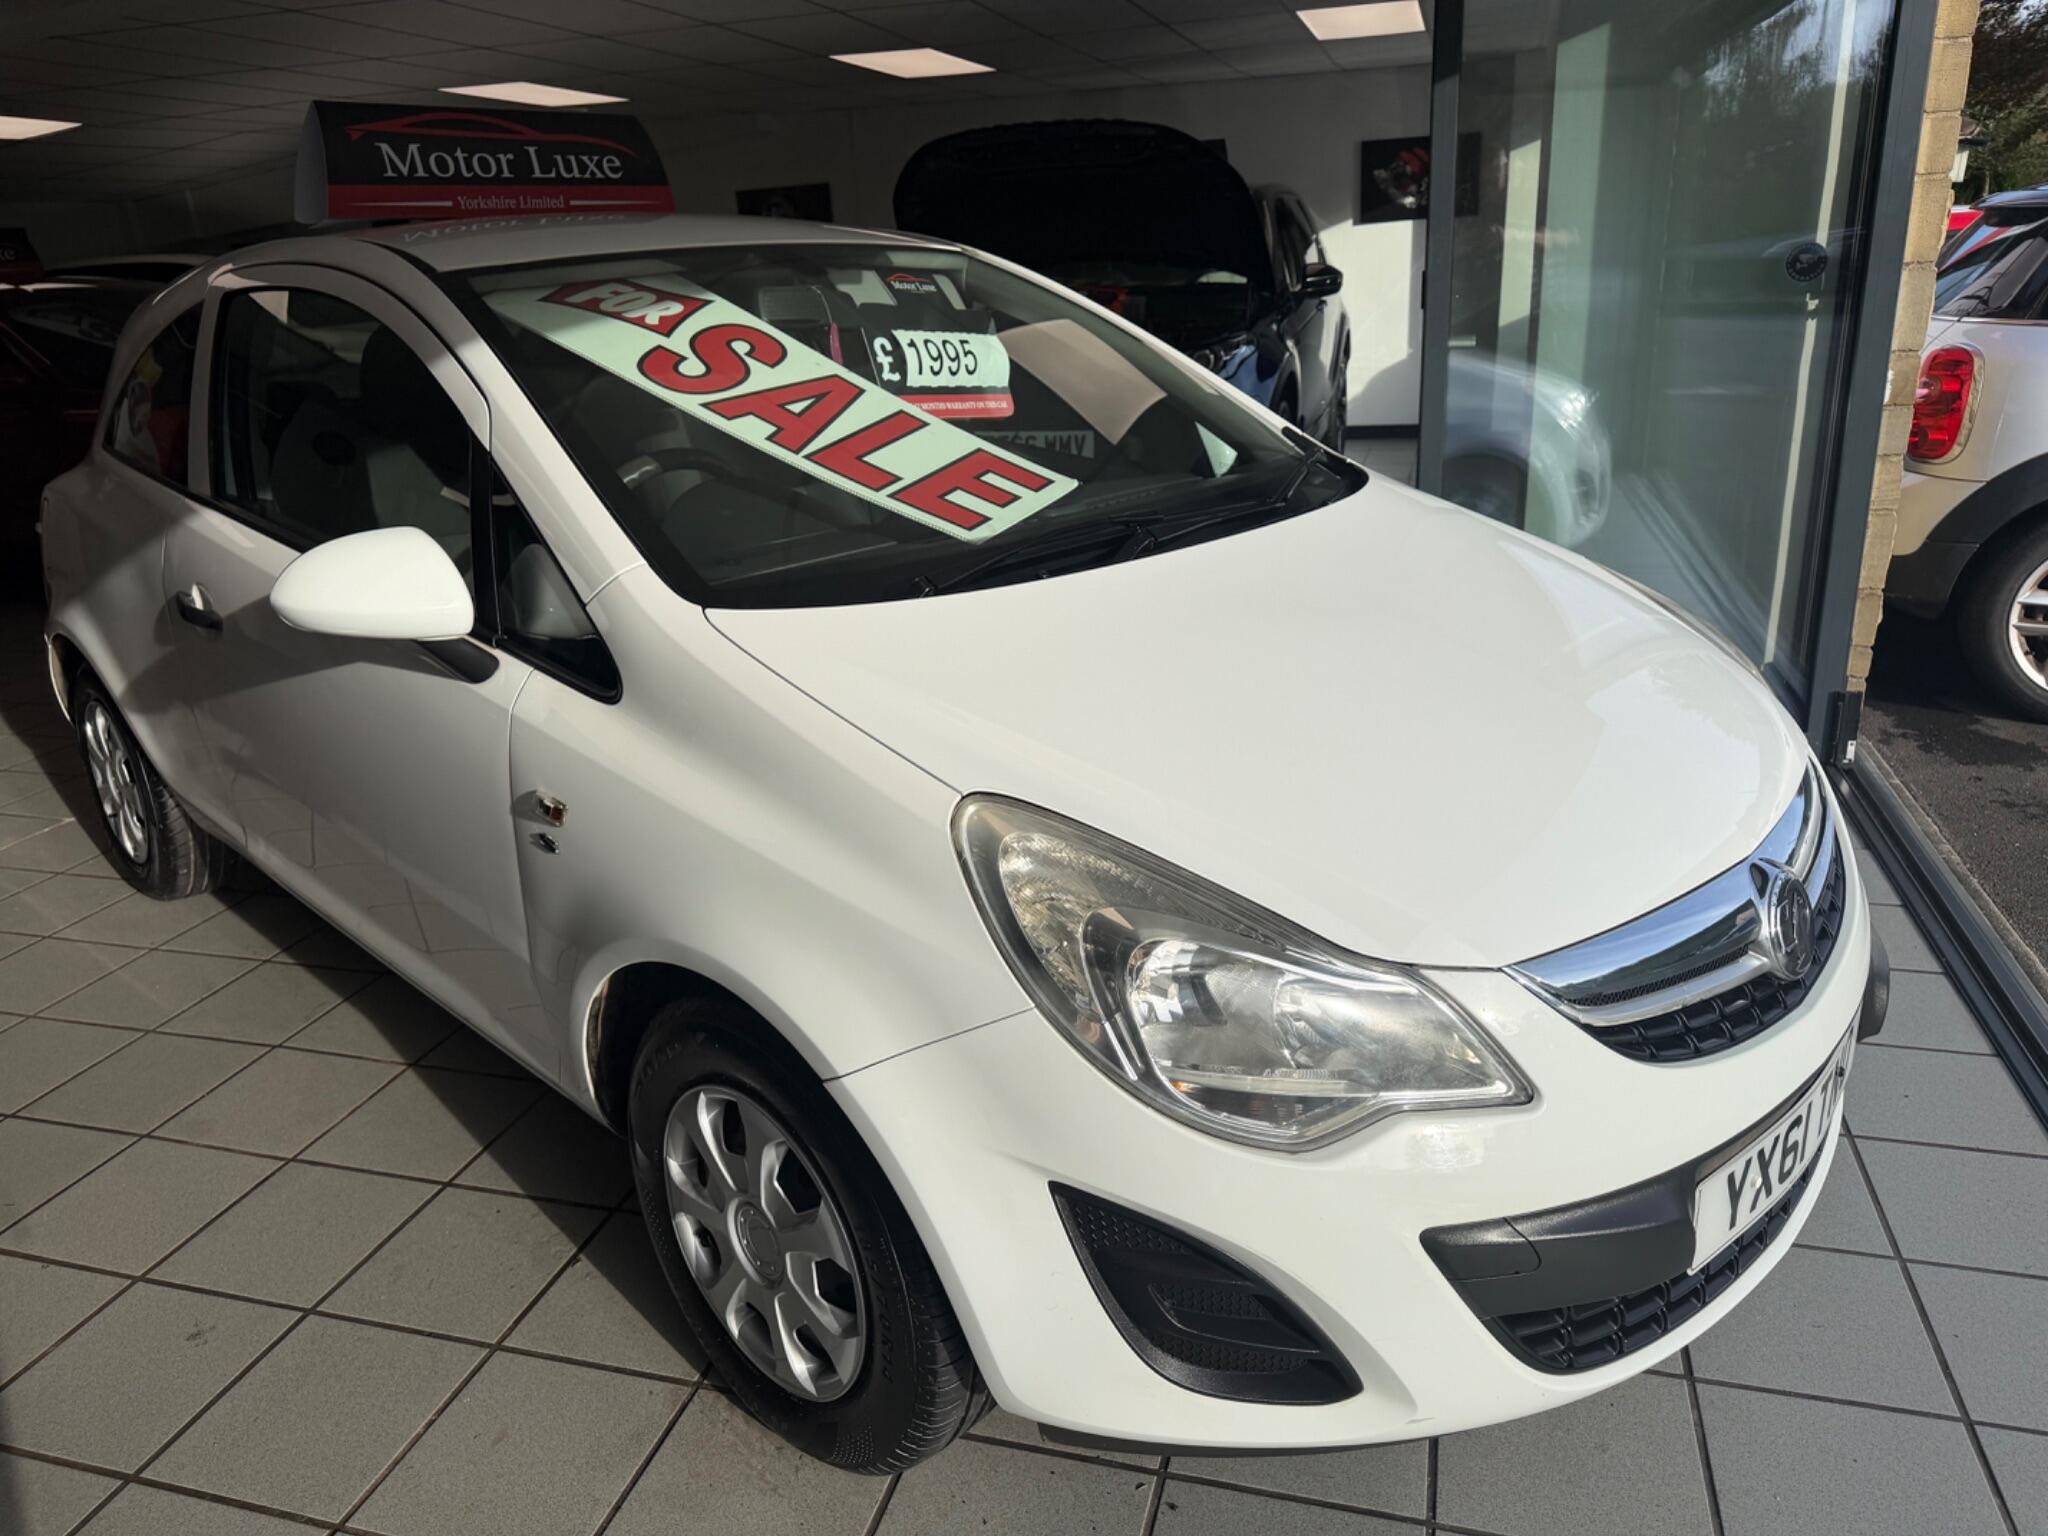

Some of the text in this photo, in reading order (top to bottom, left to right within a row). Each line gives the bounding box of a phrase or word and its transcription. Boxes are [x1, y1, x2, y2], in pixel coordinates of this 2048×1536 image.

[374, 141, 625, 180] Motor Luxe
[457, 195, 565, 209] Yorkshire Limited
[890, 280, 915, 291] Motor
[873, 336, 978, 382] £ 1995
[564, 281, 1056, 532] FOR SALE
[1727, 1101, 1812, 1231] YX61
